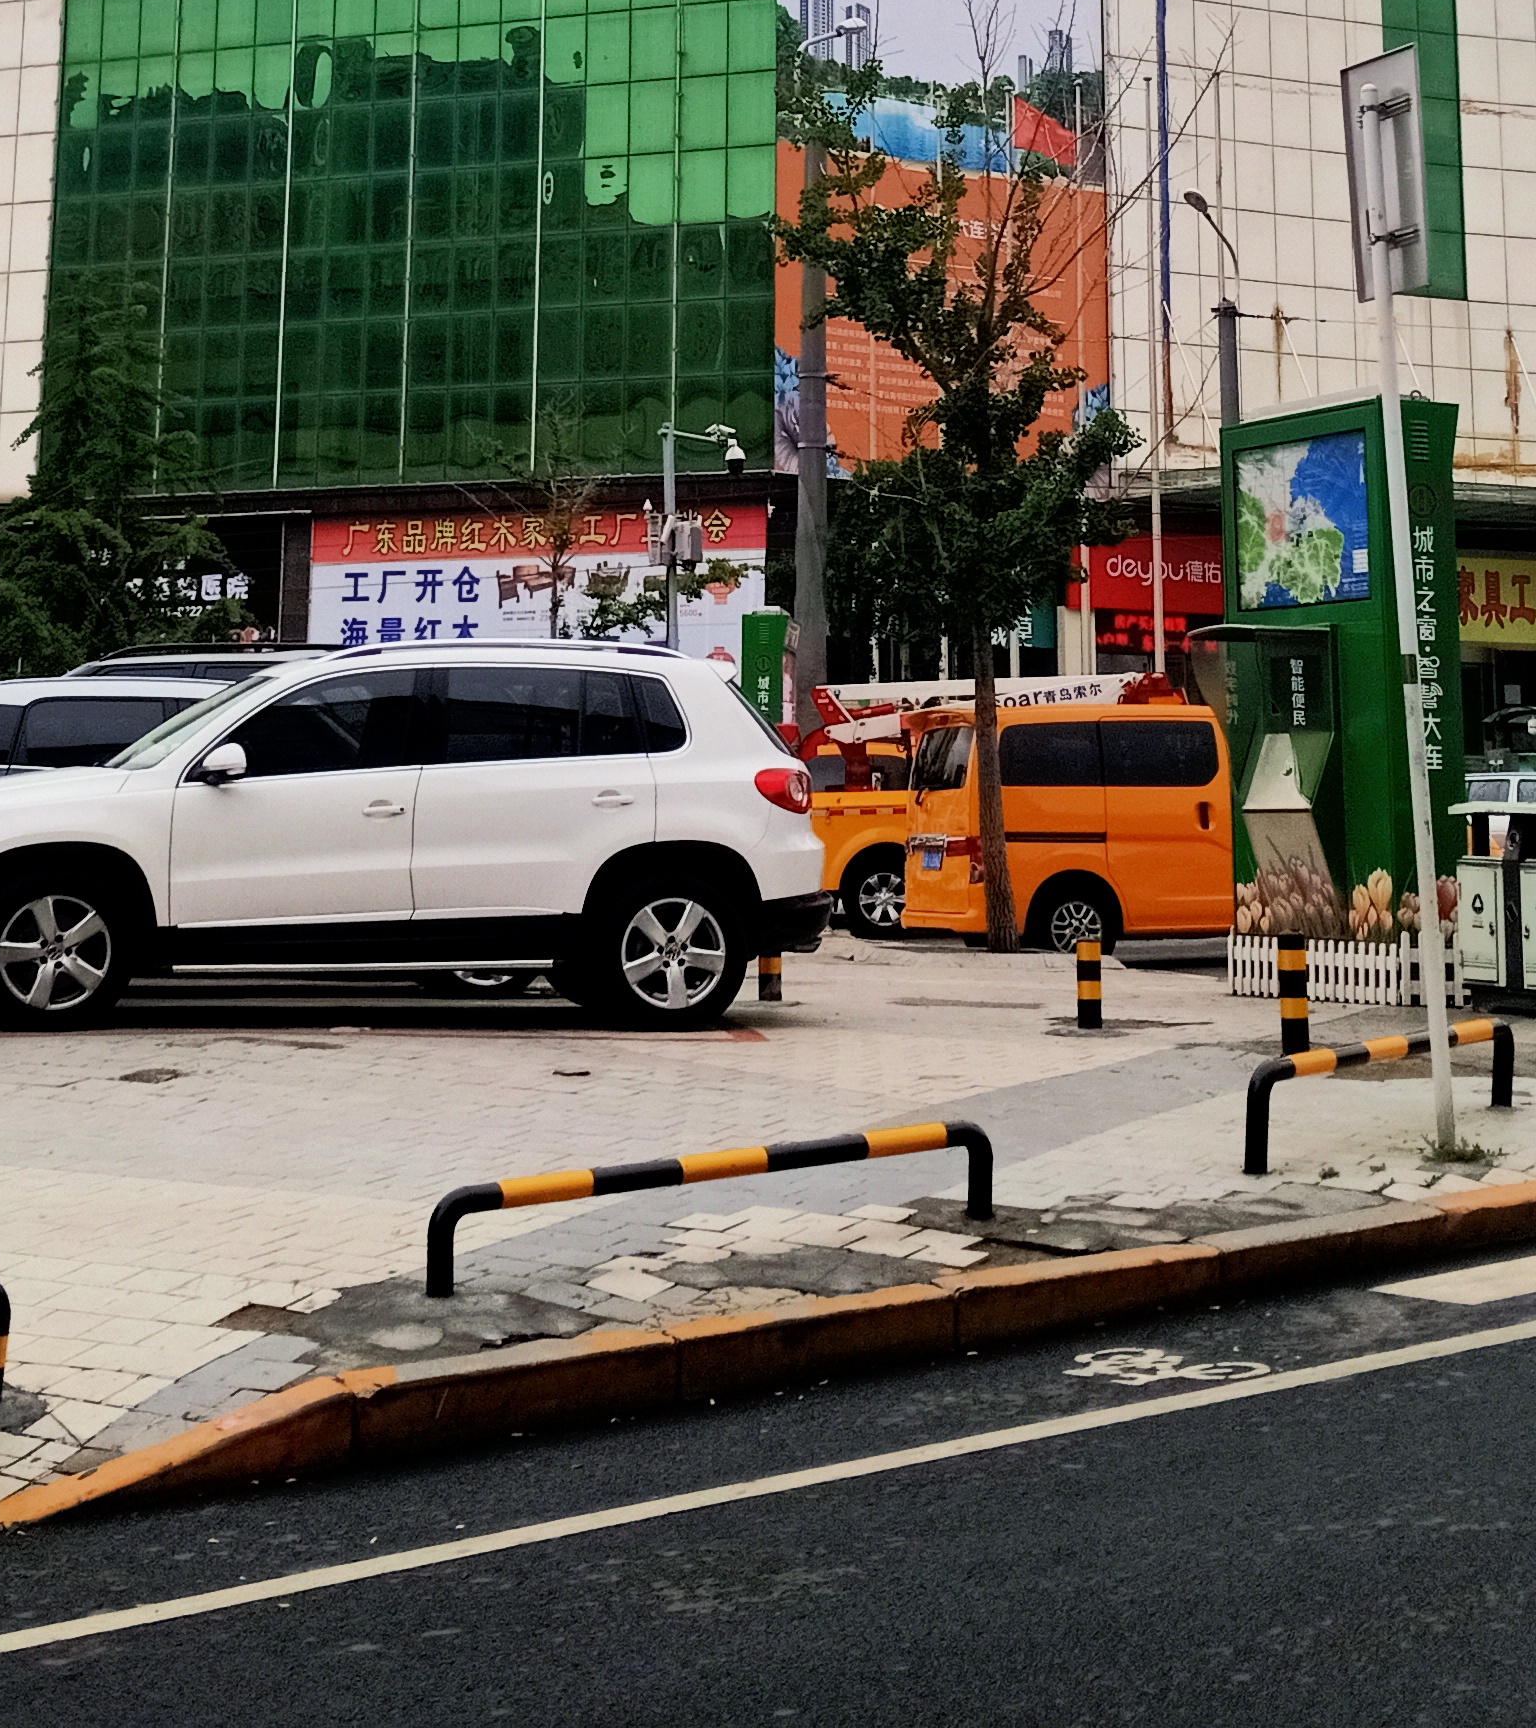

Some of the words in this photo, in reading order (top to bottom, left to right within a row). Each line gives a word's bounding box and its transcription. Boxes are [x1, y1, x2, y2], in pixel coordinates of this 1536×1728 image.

[342, 508, 733, 556] 广东品牌红木家工厂会
[341, 566, 481, 603] 工厂开仓
[1184, 560, 1222, 584] 德佑
[1043, 683, 1103, 704] 青岛索尔
[1289, 658, 1306, 726] 智能便民
